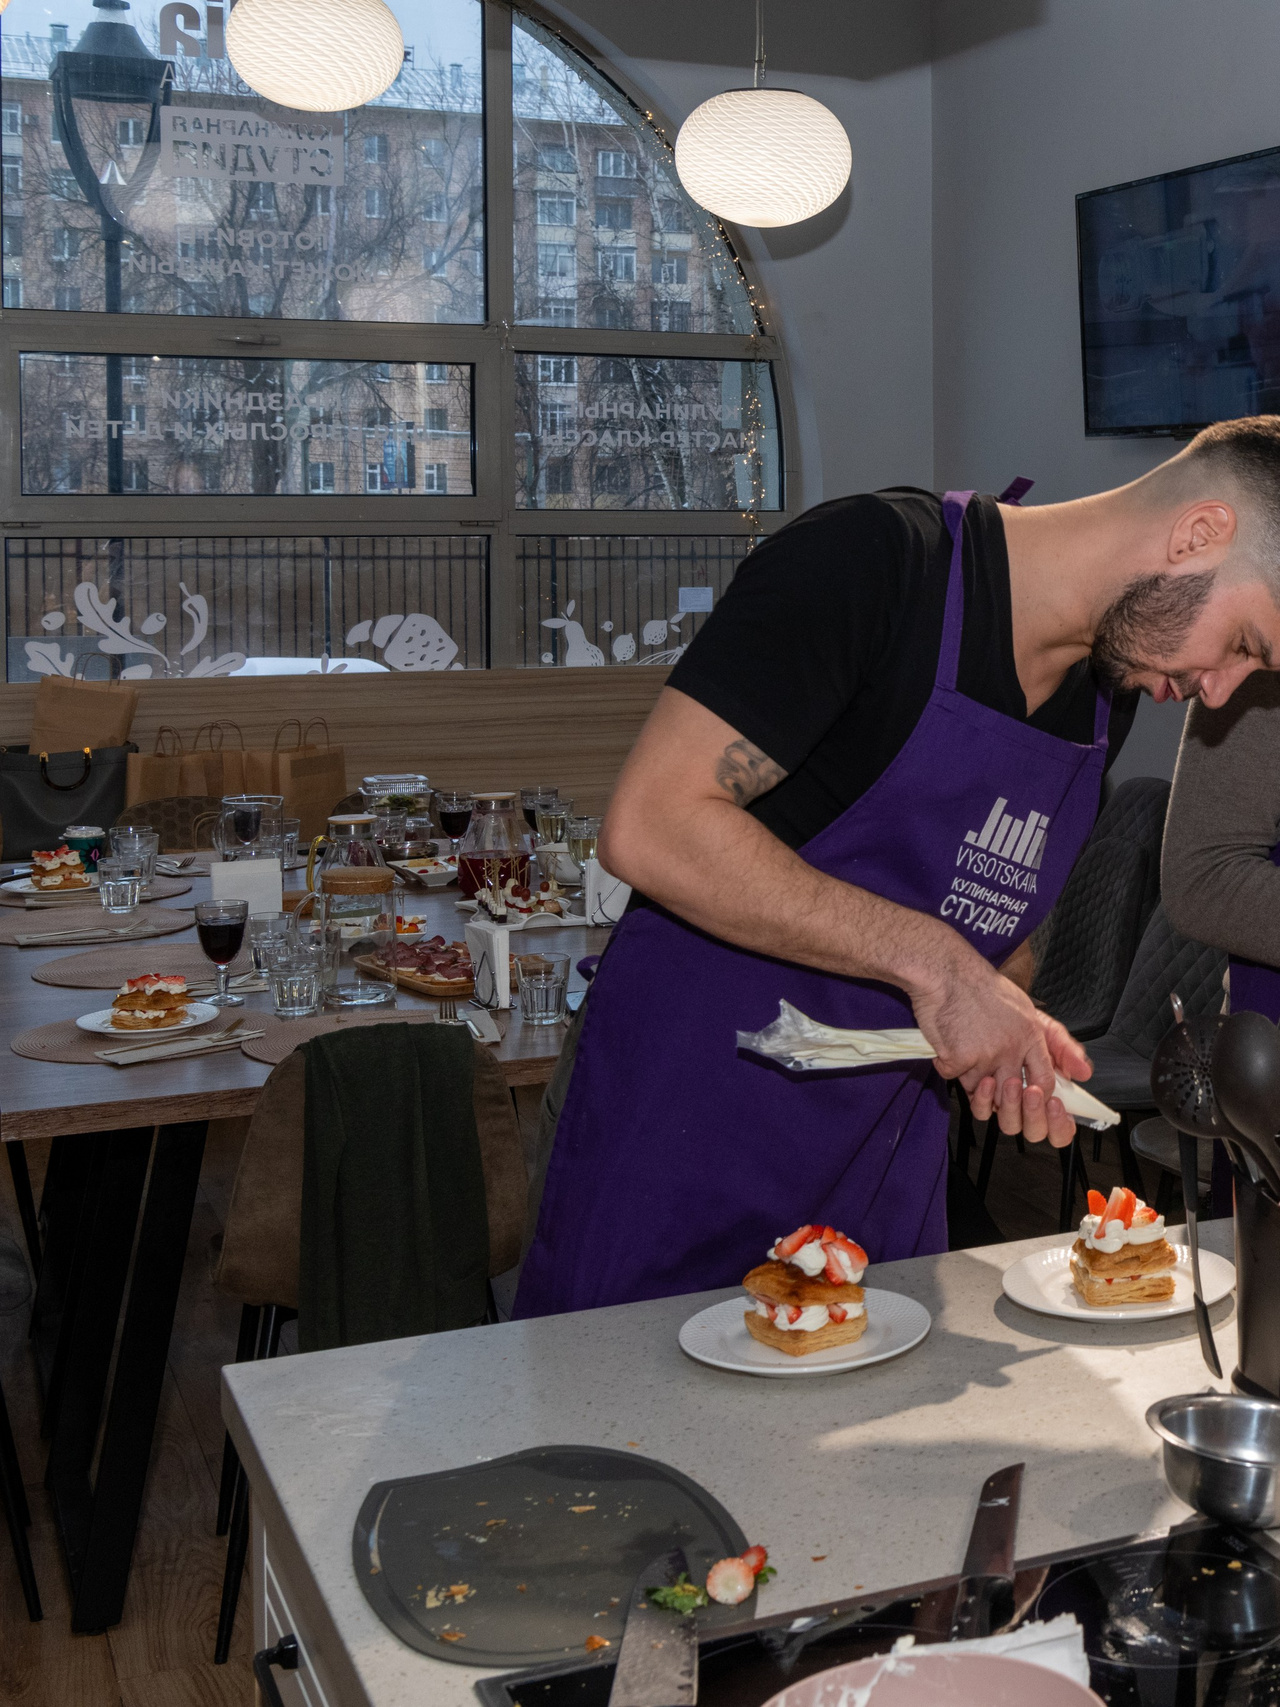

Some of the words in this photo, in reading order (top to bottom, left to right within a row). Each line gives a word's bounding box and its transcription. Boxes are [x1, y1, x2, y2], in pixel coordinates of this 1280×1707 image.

[963, 797, 1050, 870] Juli
[939, 894, 1021, 938] СТУДИЯ
[951, 876, 1029, 914] КУЛИНАРНАЯ
